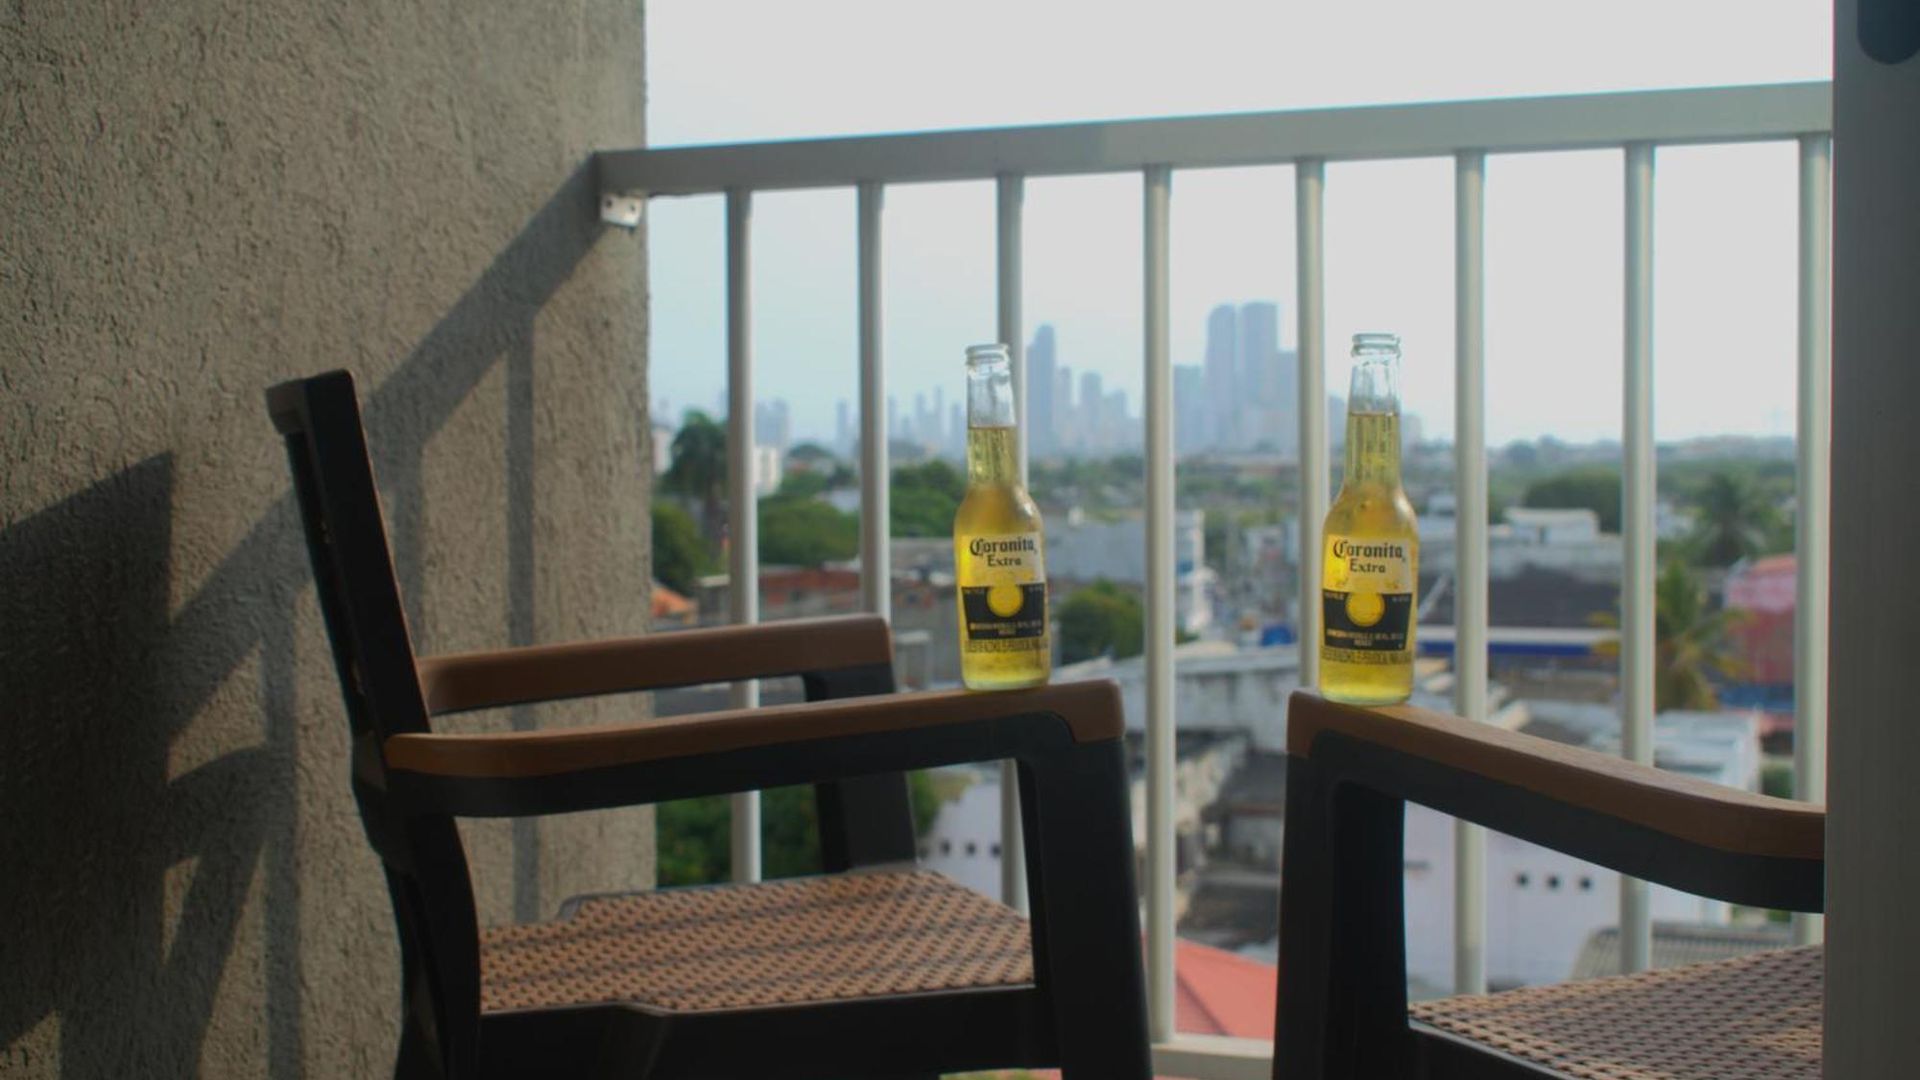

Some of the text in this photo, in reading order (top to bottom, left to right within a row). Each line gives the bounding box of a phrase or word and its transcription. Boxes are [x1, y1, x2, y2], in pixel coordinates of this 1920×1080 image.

[969, 536, 1034, 556] Coronita
[1333, 539, 1403, 558] Coronita
[987, 555, 1022, 567] Extra
[1349, 558, 1386, 573] Extra
